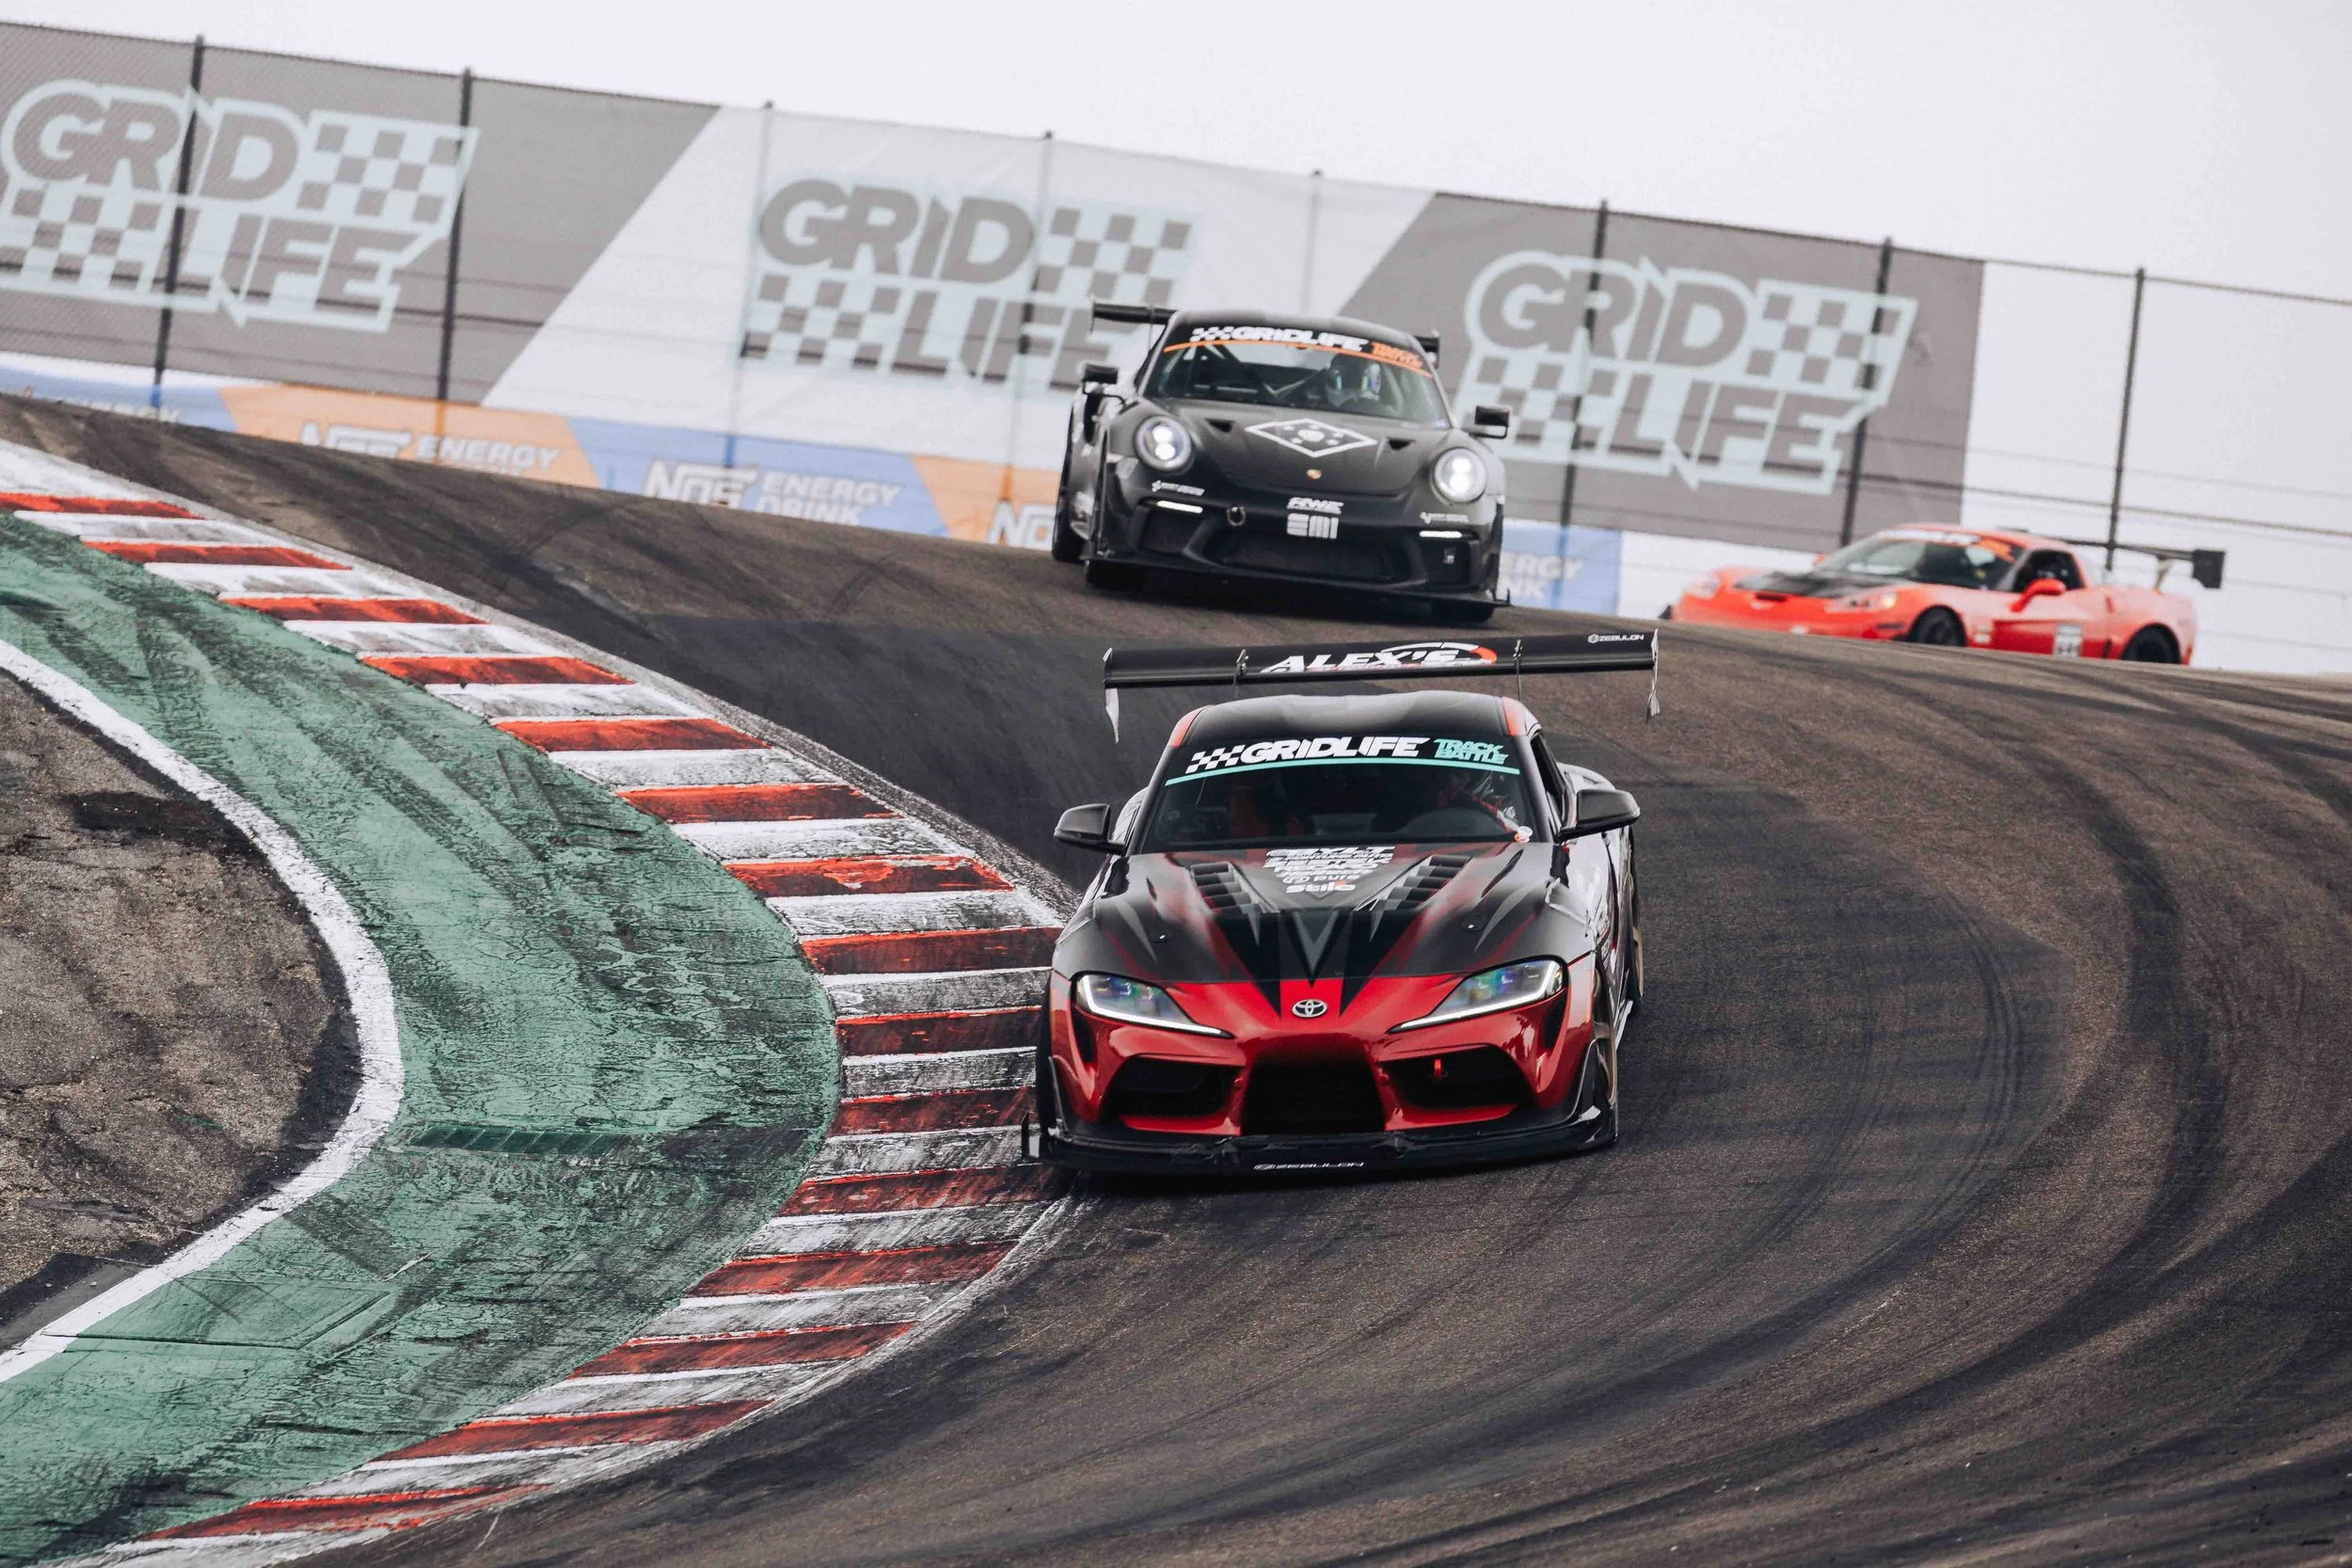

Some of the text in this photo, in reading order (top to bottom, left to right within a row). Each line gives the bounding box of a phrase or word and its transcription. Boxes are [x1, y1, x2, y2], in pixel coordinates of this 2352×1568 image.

[13, 92, 299, 201] GRID
[760, 179, 1035, 285] GRID
[152, 205, 423, 311] LIFE
[1478, 261, 1748, 370] GRID
[1231, 325, 1370, 353] GRIDLIFE
[1607, 372, 1867, 479] LIFE
[760, 470, 904, 507] ENERGY
[1598, 634, 1645, 642] ZEBULON
[1258, 649, 1461, 674] ALEX'S
[1239, 736, 1431, 765] GRIDLIFE
[1433, 737, 1505, 755] TRACK
[1434, 750, 1510, 766] BATTLE
